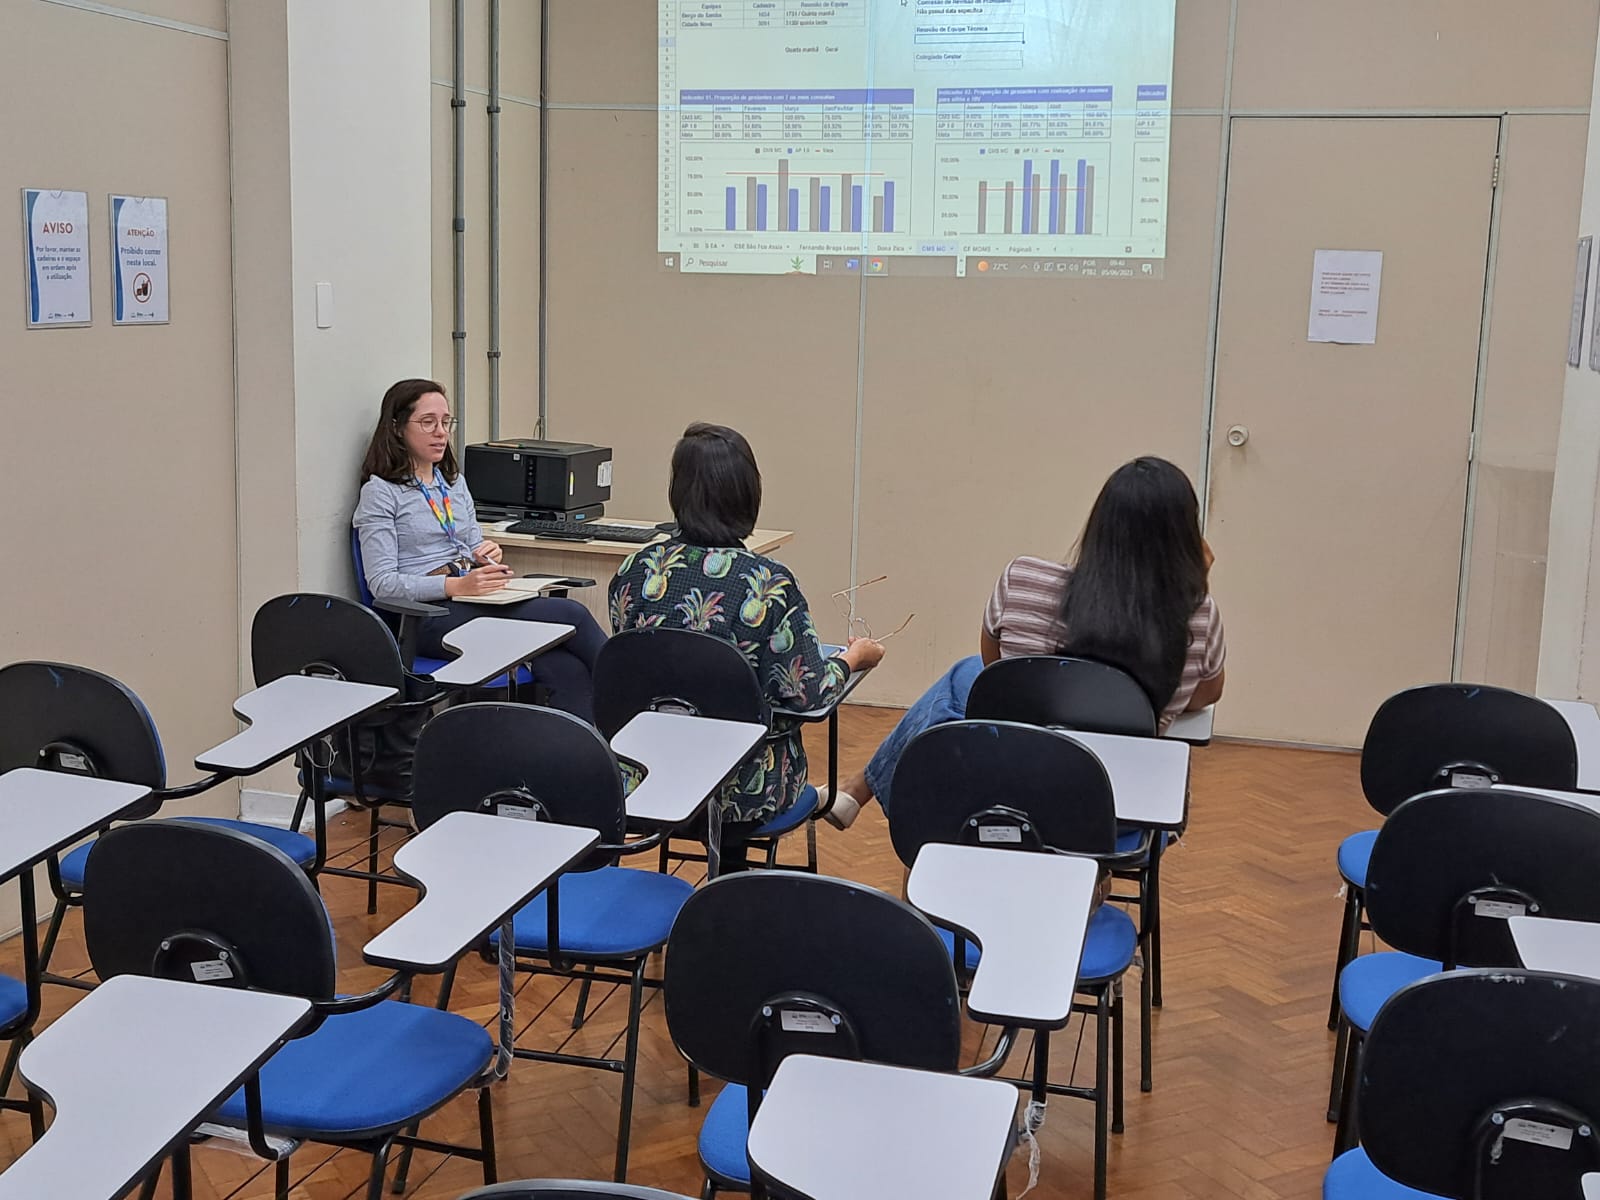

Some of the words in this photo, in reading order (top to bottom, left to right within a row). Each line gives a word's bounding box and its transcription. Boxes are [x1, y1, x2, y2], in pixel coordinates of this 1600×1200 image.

[43, 222, 73, 234] AVISO
[127, 228, 155, 238] ATENÇÃO
[120, 247, 143, 255] Proibido
